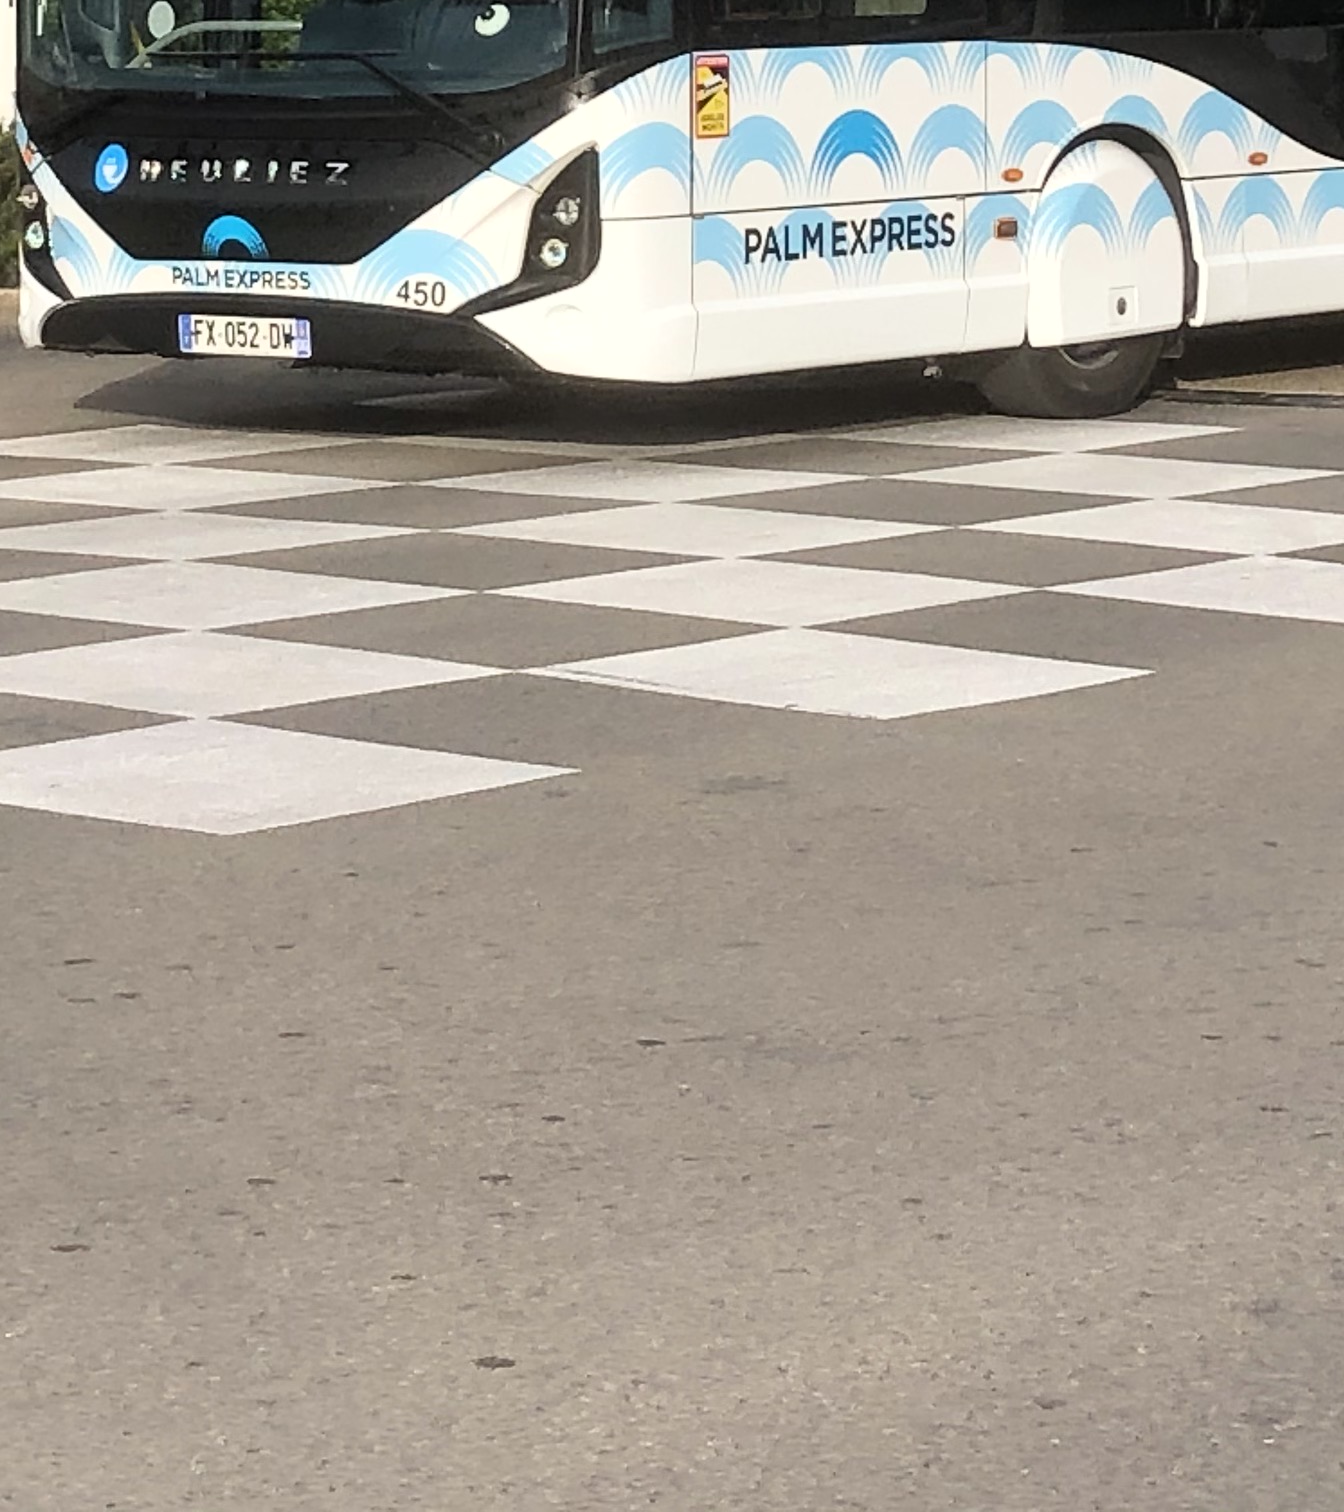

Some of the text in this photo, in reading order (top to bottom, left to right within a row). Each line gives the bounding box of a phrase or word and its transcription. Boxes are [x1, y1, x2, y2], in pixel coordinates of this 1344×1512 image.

[139, 159, 350, 186] HEULIEZ
[831, 212, 955, 257] EXPRESS
[224, 268, 311, 290] EXPRESS
[396, 279, 446, 307] 450
